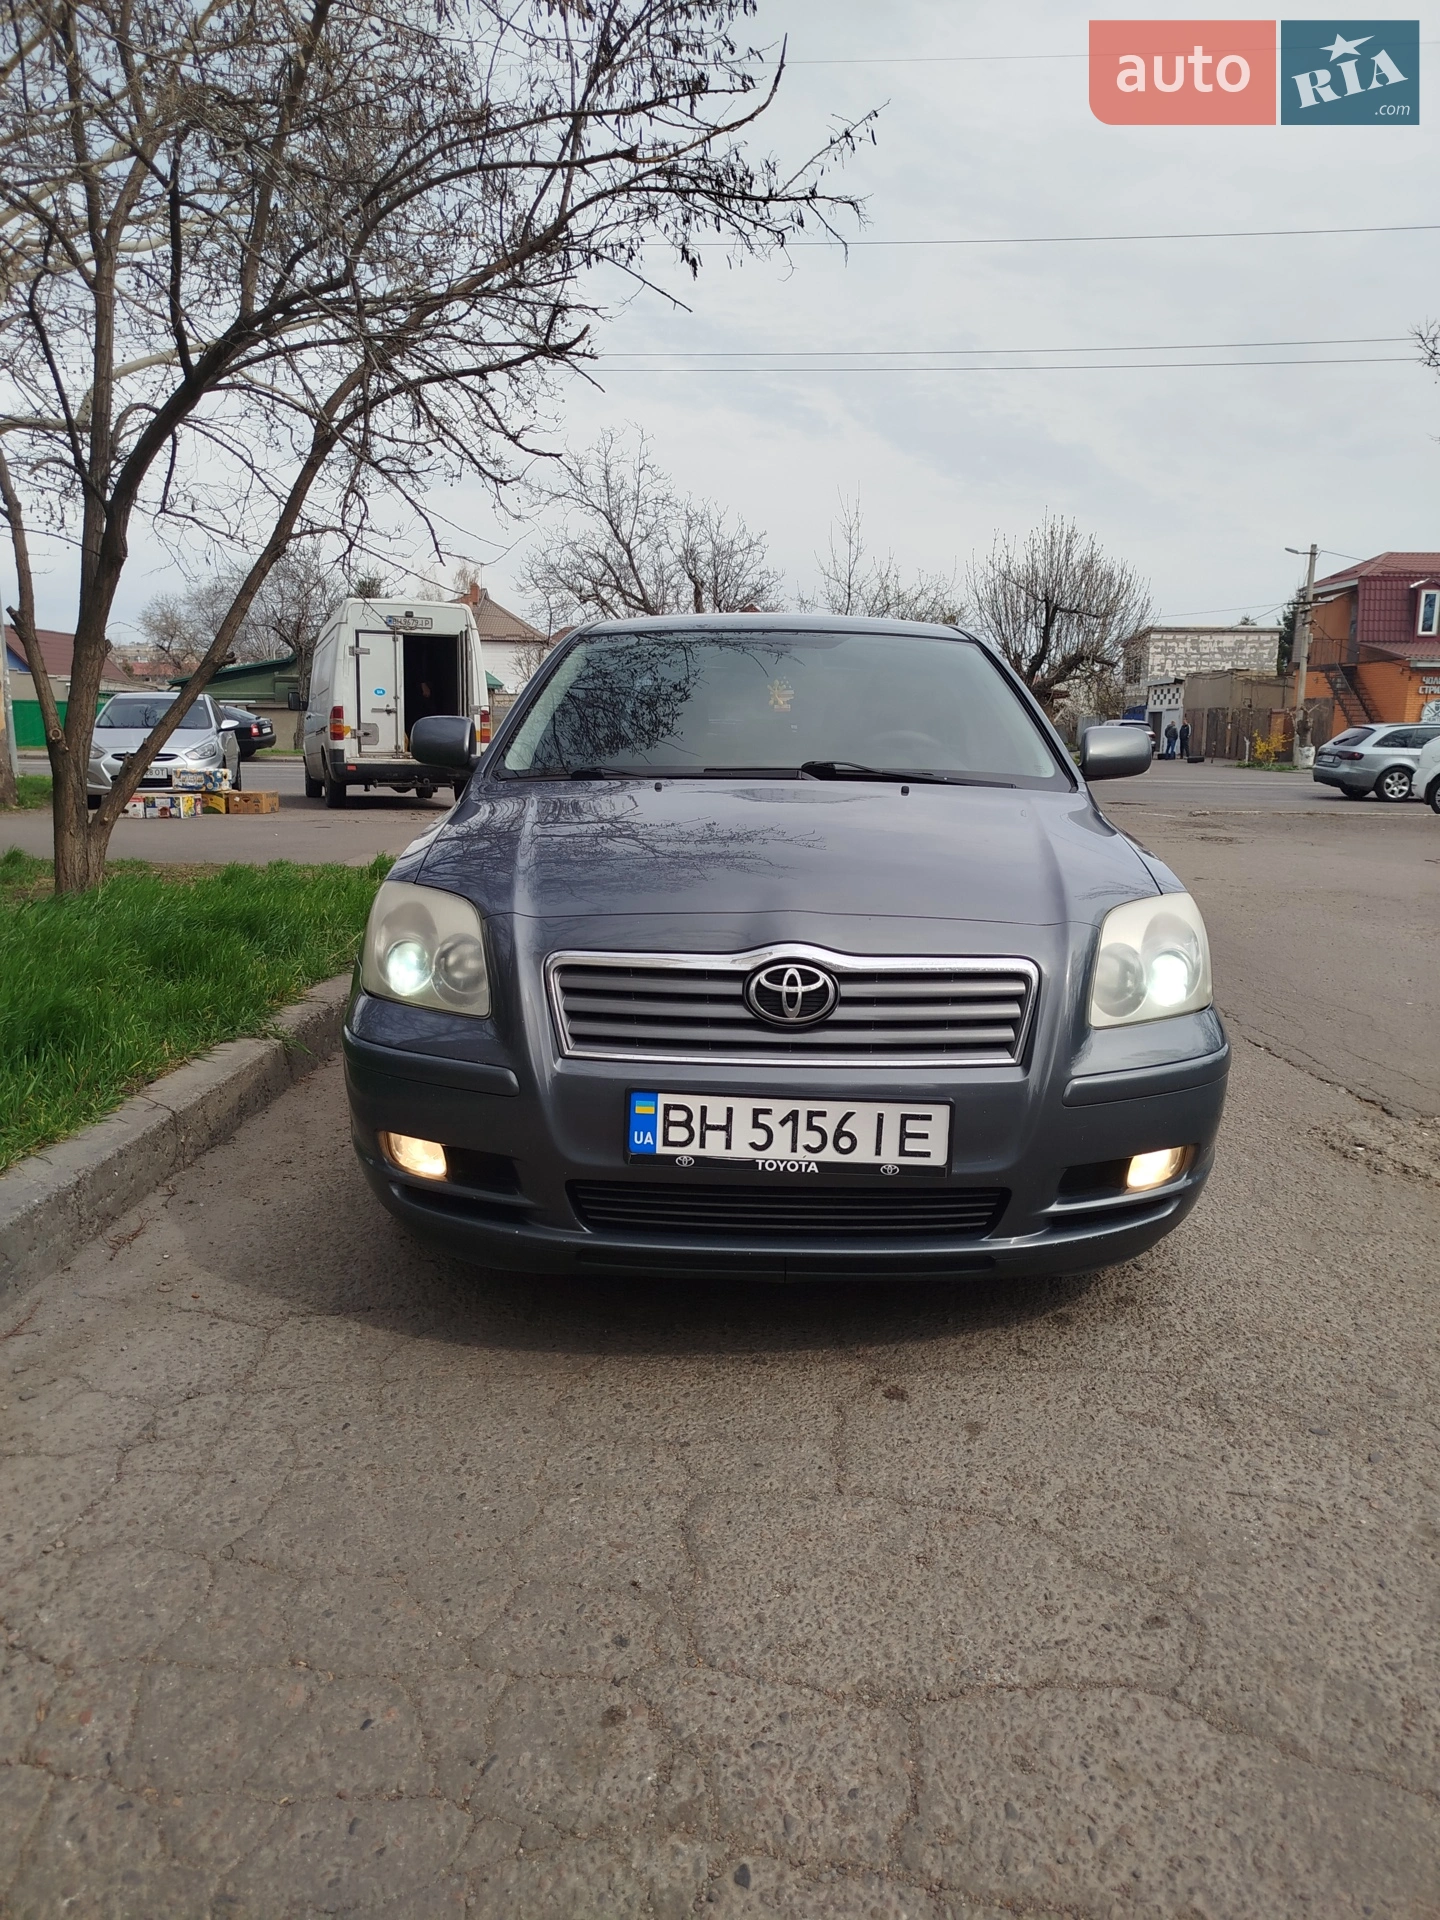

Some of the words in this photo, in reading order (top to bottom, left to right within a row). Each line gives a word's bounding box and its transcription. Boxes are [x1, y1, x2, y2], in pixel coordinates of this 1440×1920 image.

[633, 1130, 654, 1146] UA
[662, 1102, 734, 1150] BH
[748, 1107, 858, 1155] 5156
[874, 1111, 933, 1158] IE
[755, 1159, 819, 1174] TOYOTA
